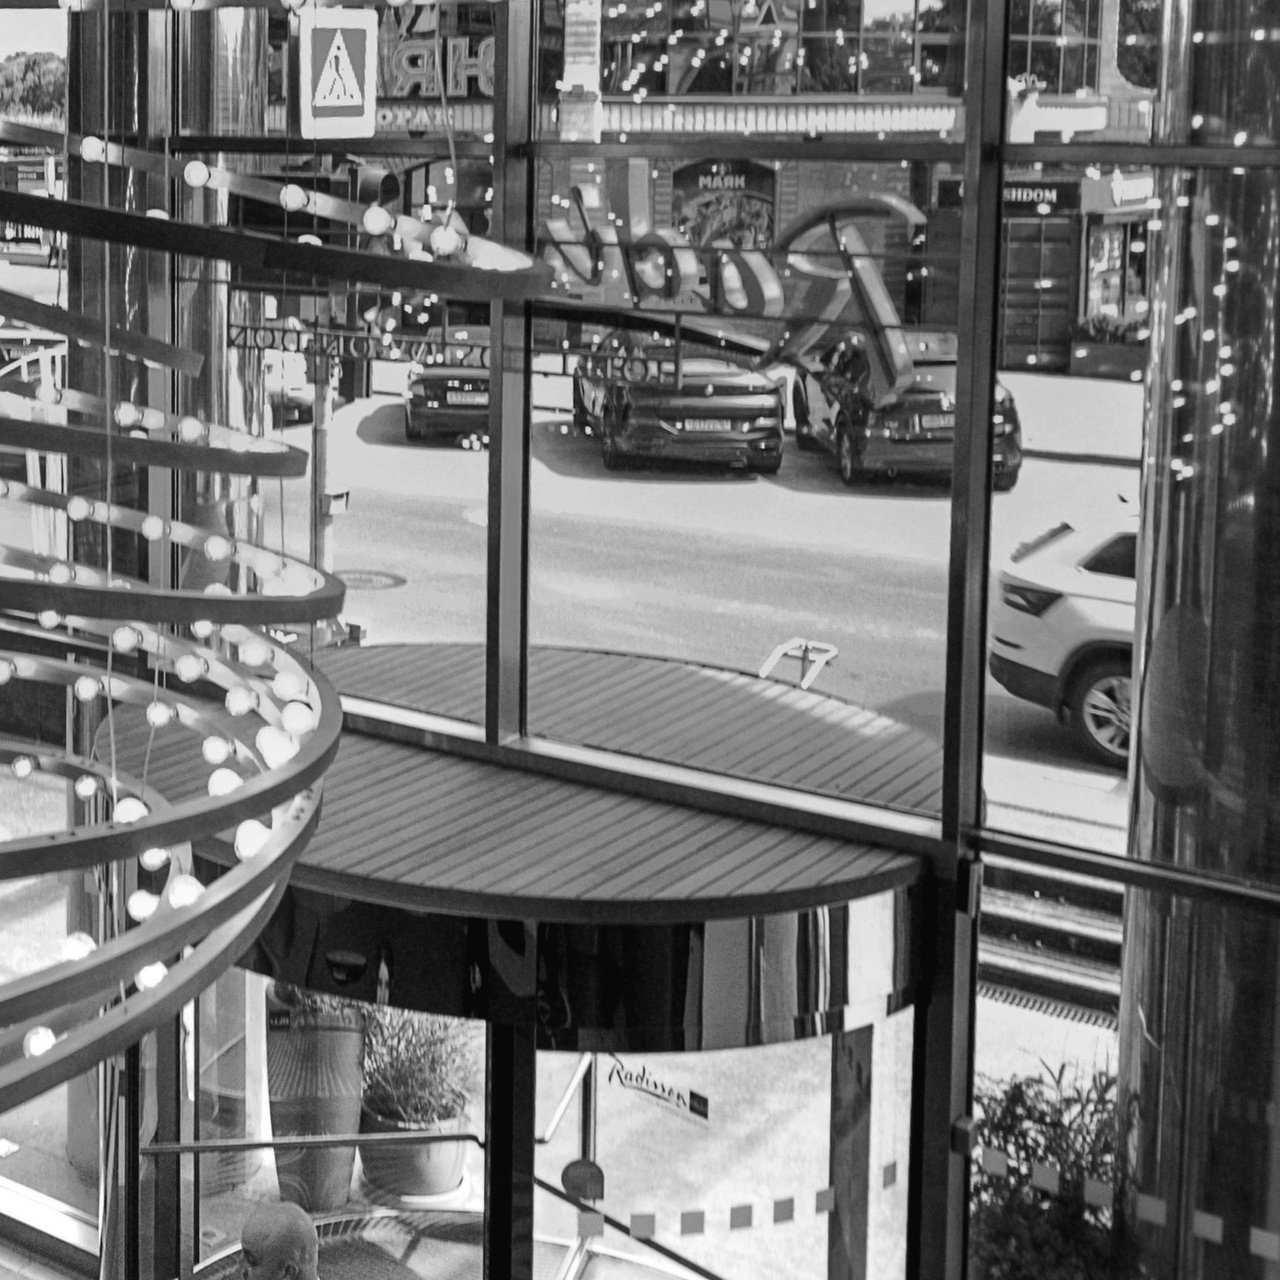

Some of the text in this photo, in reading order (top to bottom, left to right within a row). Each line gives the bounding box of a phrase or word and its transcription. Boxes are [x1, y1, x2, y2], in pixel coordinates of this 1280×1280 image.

[699, 175, 746, 190] МАЯК
[1003, 187, 1058, 203] SHDOM
[607, 1053, 688, 1109] Radisson
